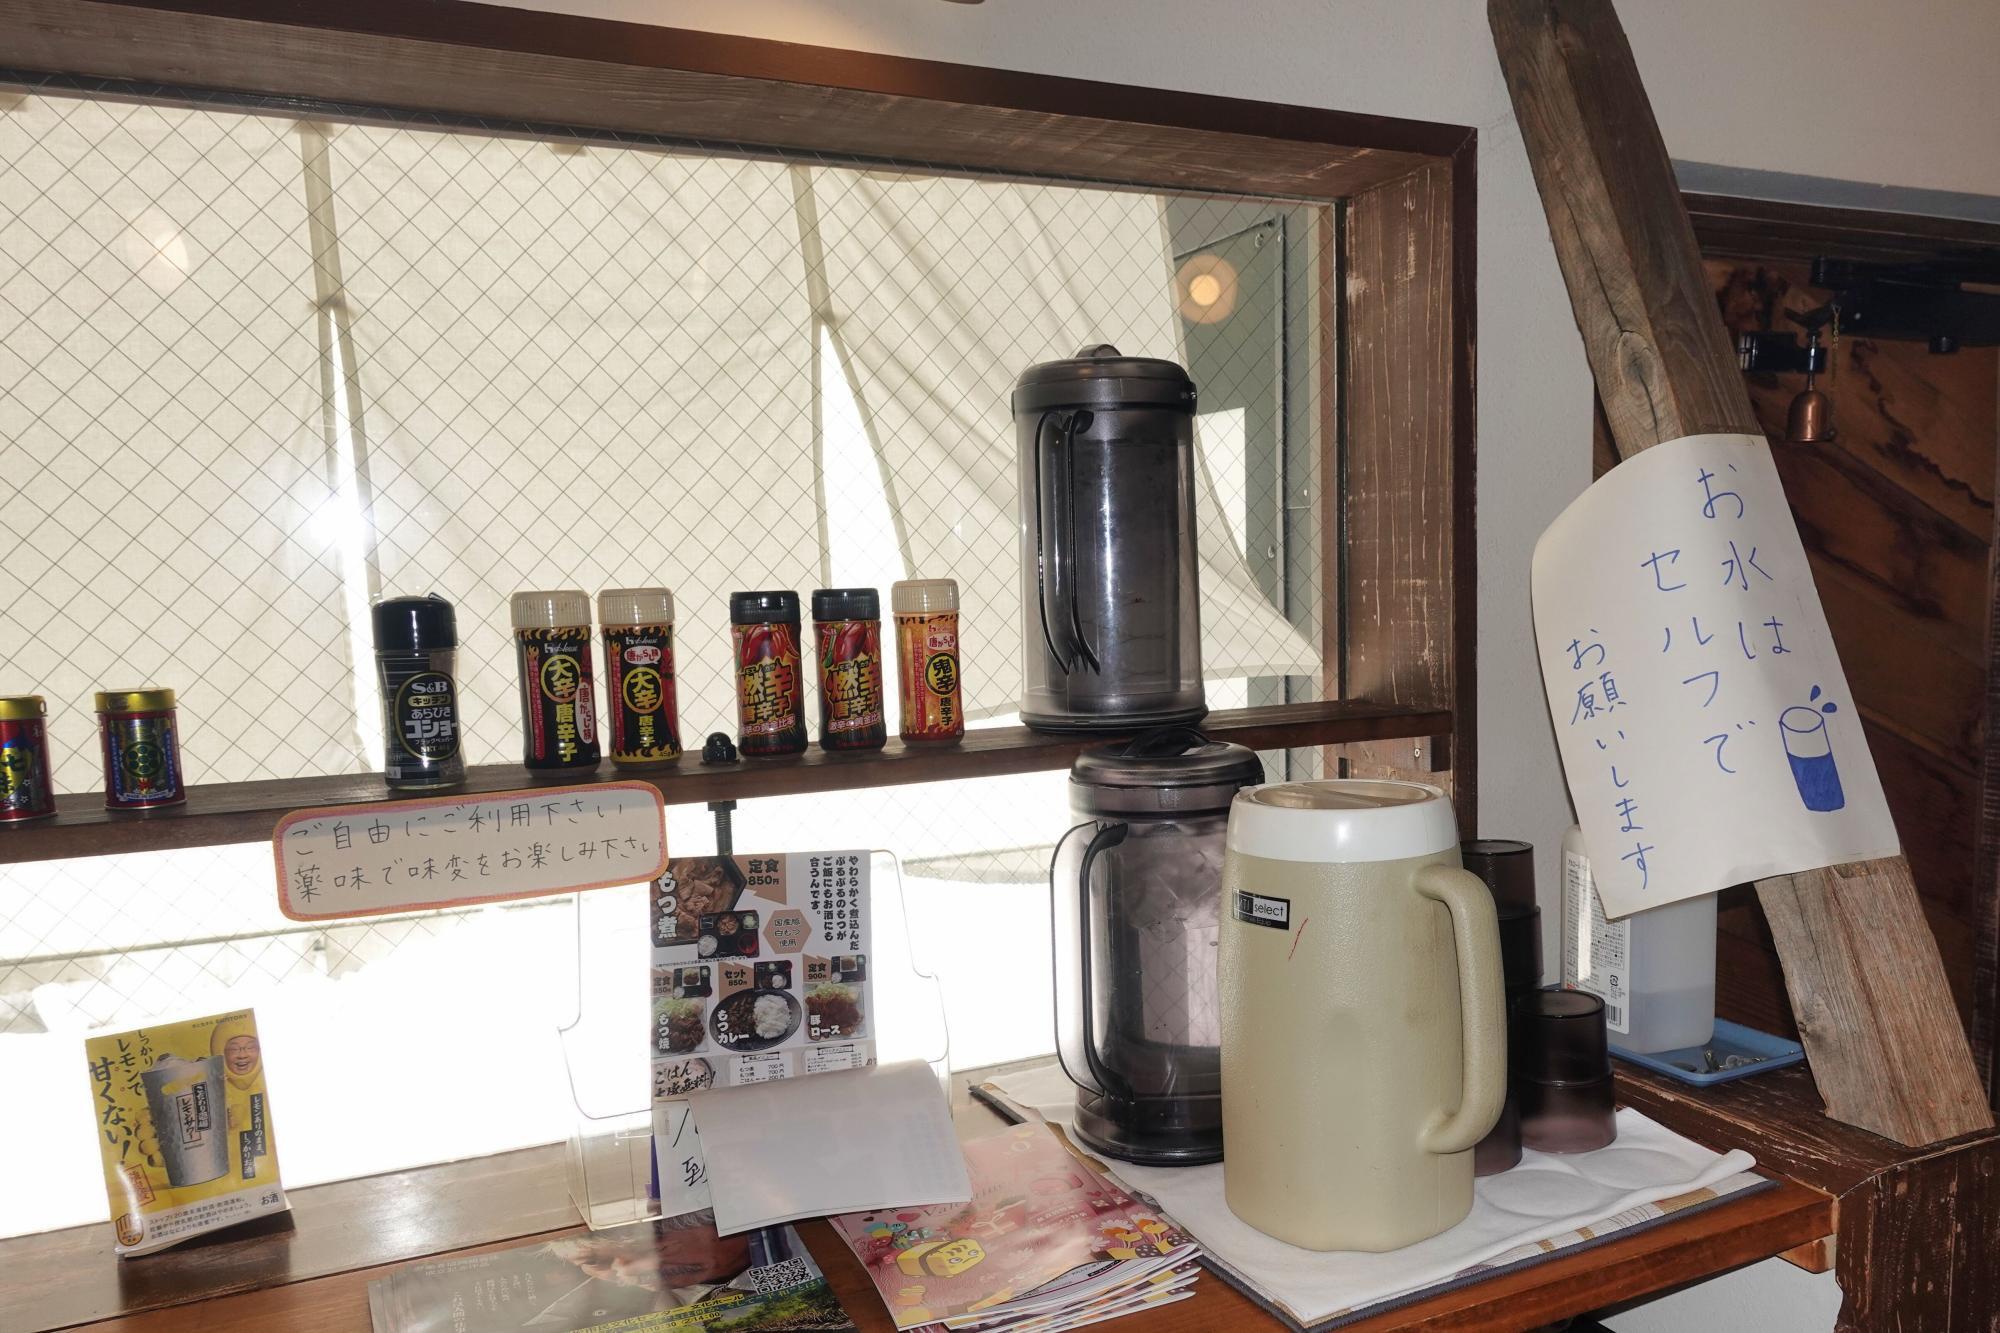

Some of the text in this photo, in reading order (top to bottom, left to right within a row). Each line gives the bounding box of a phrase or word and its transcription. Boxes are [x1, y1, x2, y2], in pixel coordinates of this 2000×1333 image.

[1698, 463, 1791, 660] お水は
[933, 658, 955, 690] 鬼辛
[1641, 548, 1756, 775] セルフで
[411, 680, 448, 694] S&B
[548, 659, 578, 699] 大辛
[631, 672, 658, 709] 大辛
[411, 707, 452, 720] あらびき
[412, 696, 450, 706] キッチン
[940, 697, 954, 726] 唐辛子
[405, 720, 458, 739] コショー
[555, 704, 577, 763] 唐辛子
[639, 715, 656, 748] 唐辛子
[1565, 628, 1655, 891] お願いします
[291, 798, 624, 857] ご自由にご利用下さい
[294, 834, 662, 904] 薬味で味変をお楽しみ下さい
[748, 859, 779, 874] 定食
[748, 874, 779, 886] 850円
[809, 857, 821, 916] 合うんです。
[822, 856, 834, 941] ご飯にもお酒にも
[848, 855, 860, 951] やわらかく煮込んだ
[657, 871, 677, 939] もつ煮
[1254, 903, 1284, 917] select
[653, 976, 671, 986] 定食
[724, 968, 746, 979] セット
[808, 963, 827, 973] 定食
[808, 972, 827, 980] 900円
[137, 1029, 154, 1067] しっかり
[117, 1039, 145, 1096] レモンで
[654, 1061, 692, 1085] ごはん
[182, 1097, 198, 1142] レモンサワー
[261, 1191, 279, 1206] お酒
